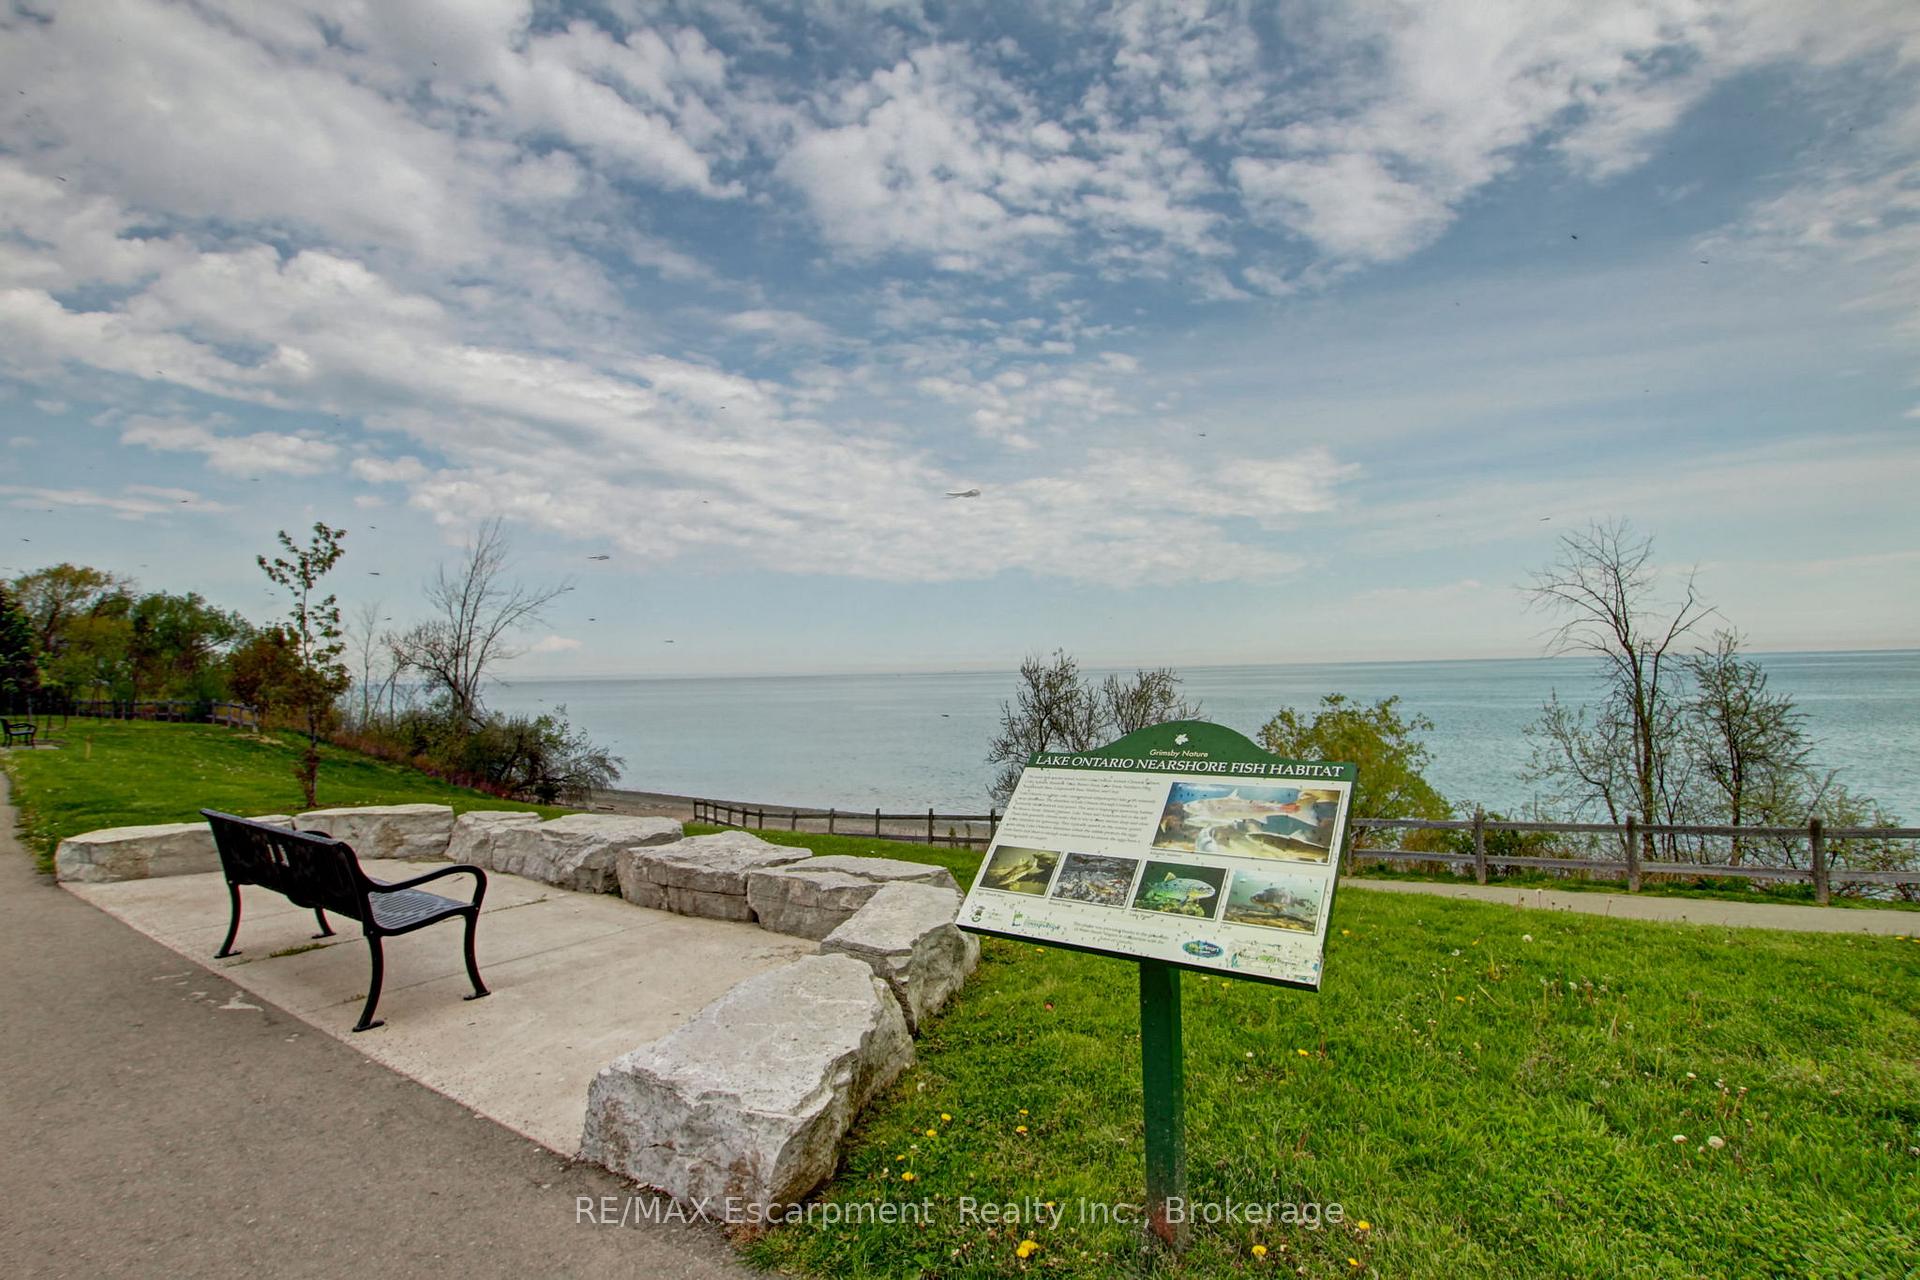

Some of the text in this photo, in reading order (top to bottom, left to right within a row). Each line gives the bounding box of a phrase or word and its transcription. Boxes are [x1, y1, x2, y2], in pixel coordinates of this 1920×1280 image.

[1149, 749, 1209, 758] Grimsby Nature
[1035, 755, 1345, 777] LAKE ONTARIO NEARSHORE FISH HABITAT
